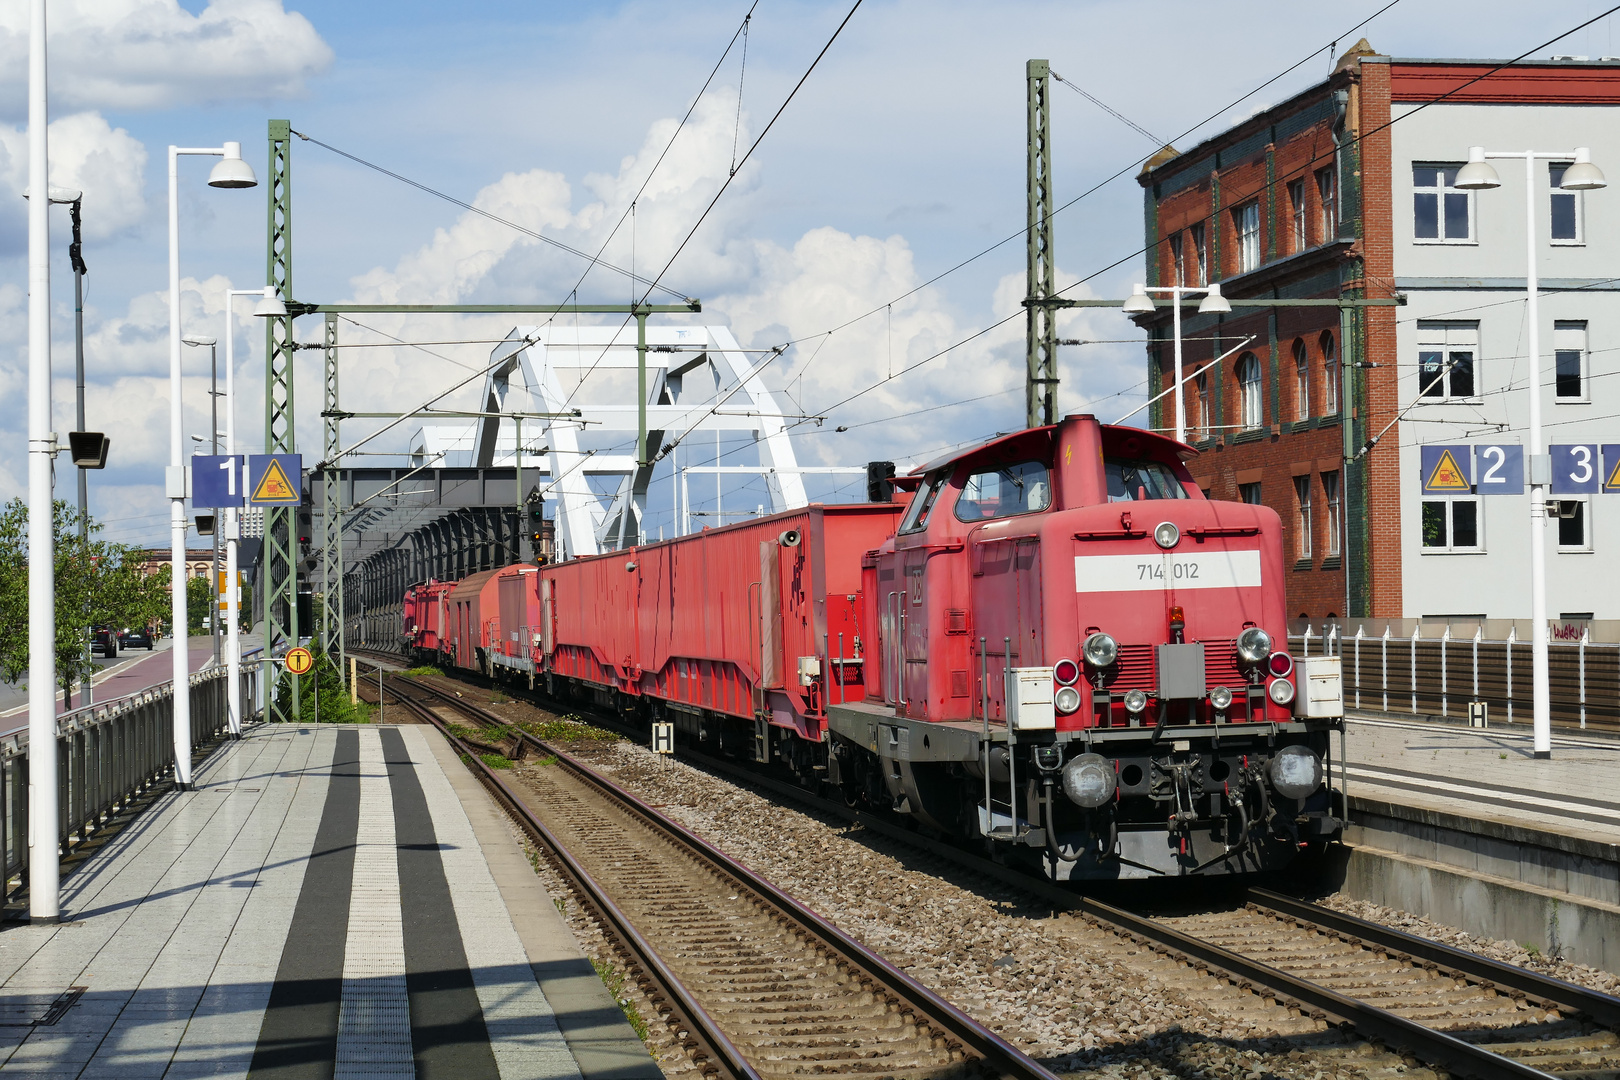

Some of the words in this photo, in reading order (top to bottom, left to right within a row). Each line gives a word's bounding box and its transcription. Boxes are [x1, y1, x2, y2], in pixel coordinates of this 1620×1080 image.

[219, 457, 235, 495] 1
[1483, 446, 1506, 484] 2
[1569, 446, 1593, 483] 3
[1137, 564, 1164, 580] 714
[1173, 563, 1199, 579] 012
[1471, 705, 1486, 728] H
[655, 726, 671, 751] H
